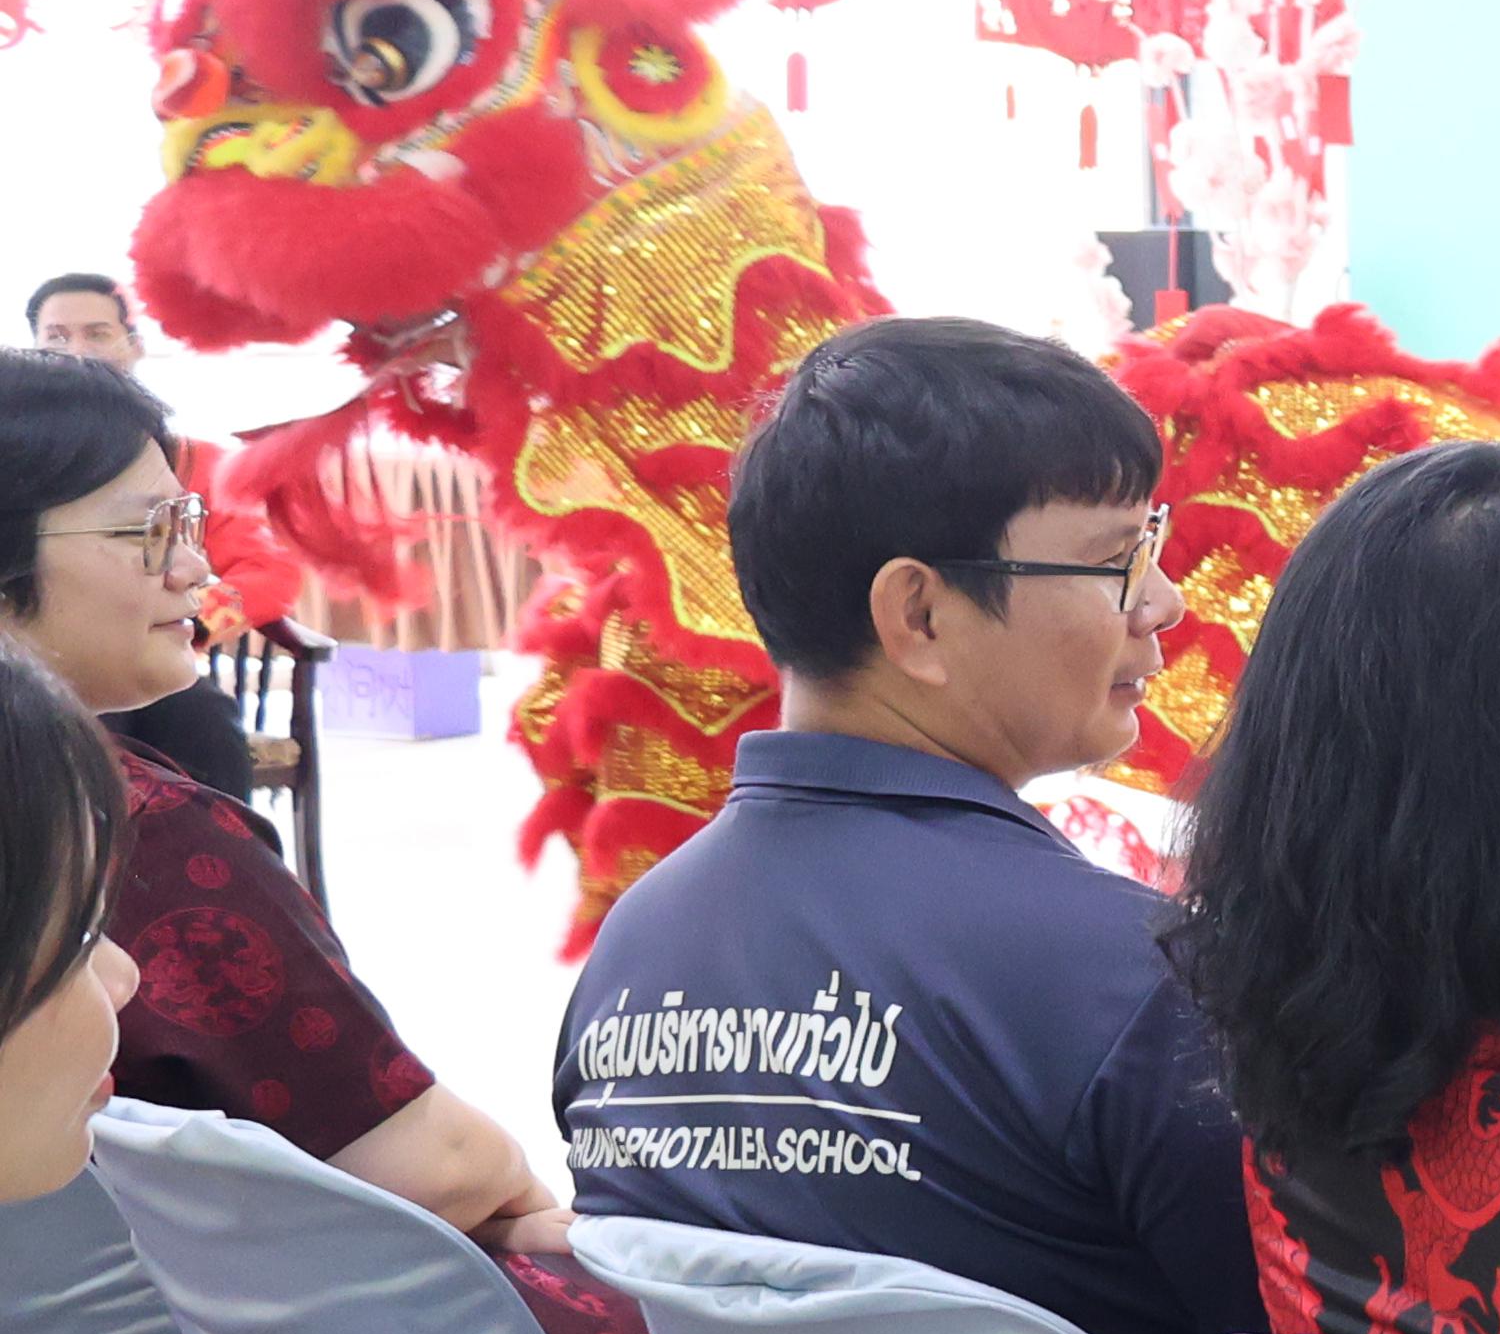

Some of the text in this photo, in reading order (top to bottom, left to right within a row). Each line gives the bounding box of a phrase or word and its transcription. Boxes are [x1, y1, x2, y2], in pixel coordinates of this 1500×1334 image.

[578, 970, 903, 1108] กลุ่มบริหารงานทั่วไป
[772, 1128, 922, 1181] SCHOOL
